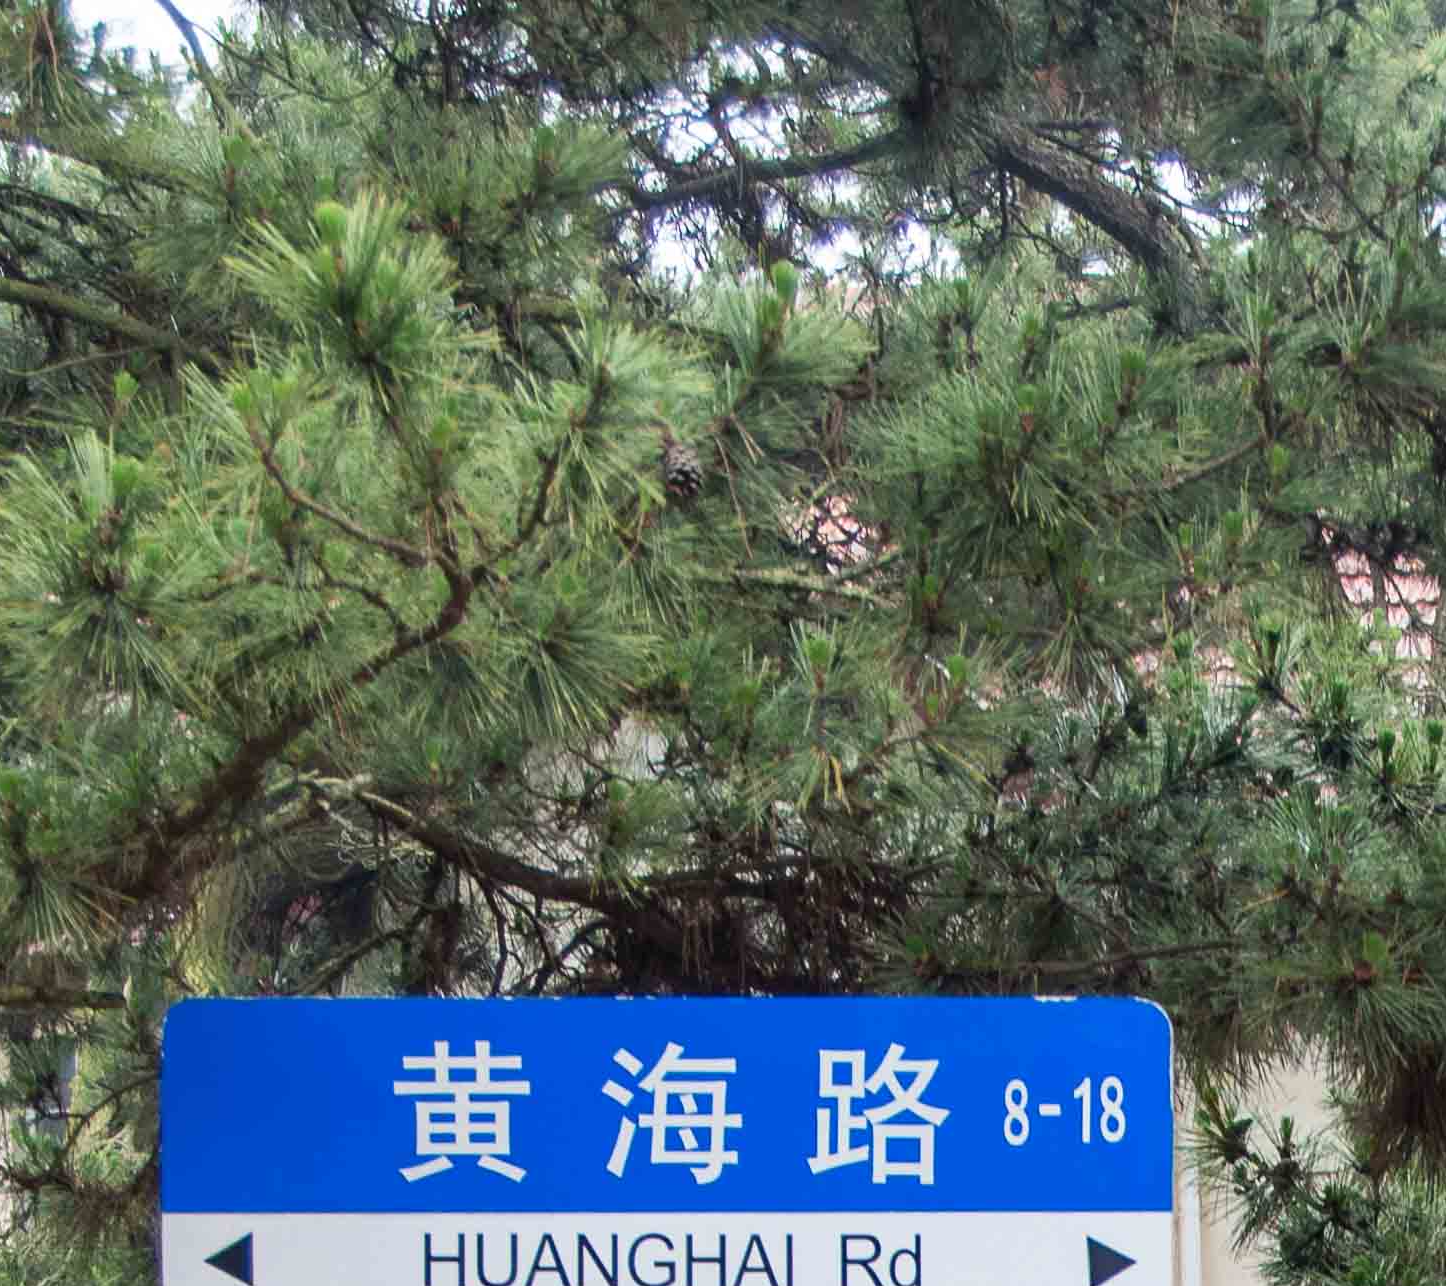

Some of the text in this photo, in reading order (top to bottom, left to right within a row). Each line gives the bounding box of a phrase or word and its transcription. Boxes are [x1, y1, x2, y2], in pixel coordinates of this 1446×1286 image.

[393, 1039, 1127, 1185] 黄海路 8-18
